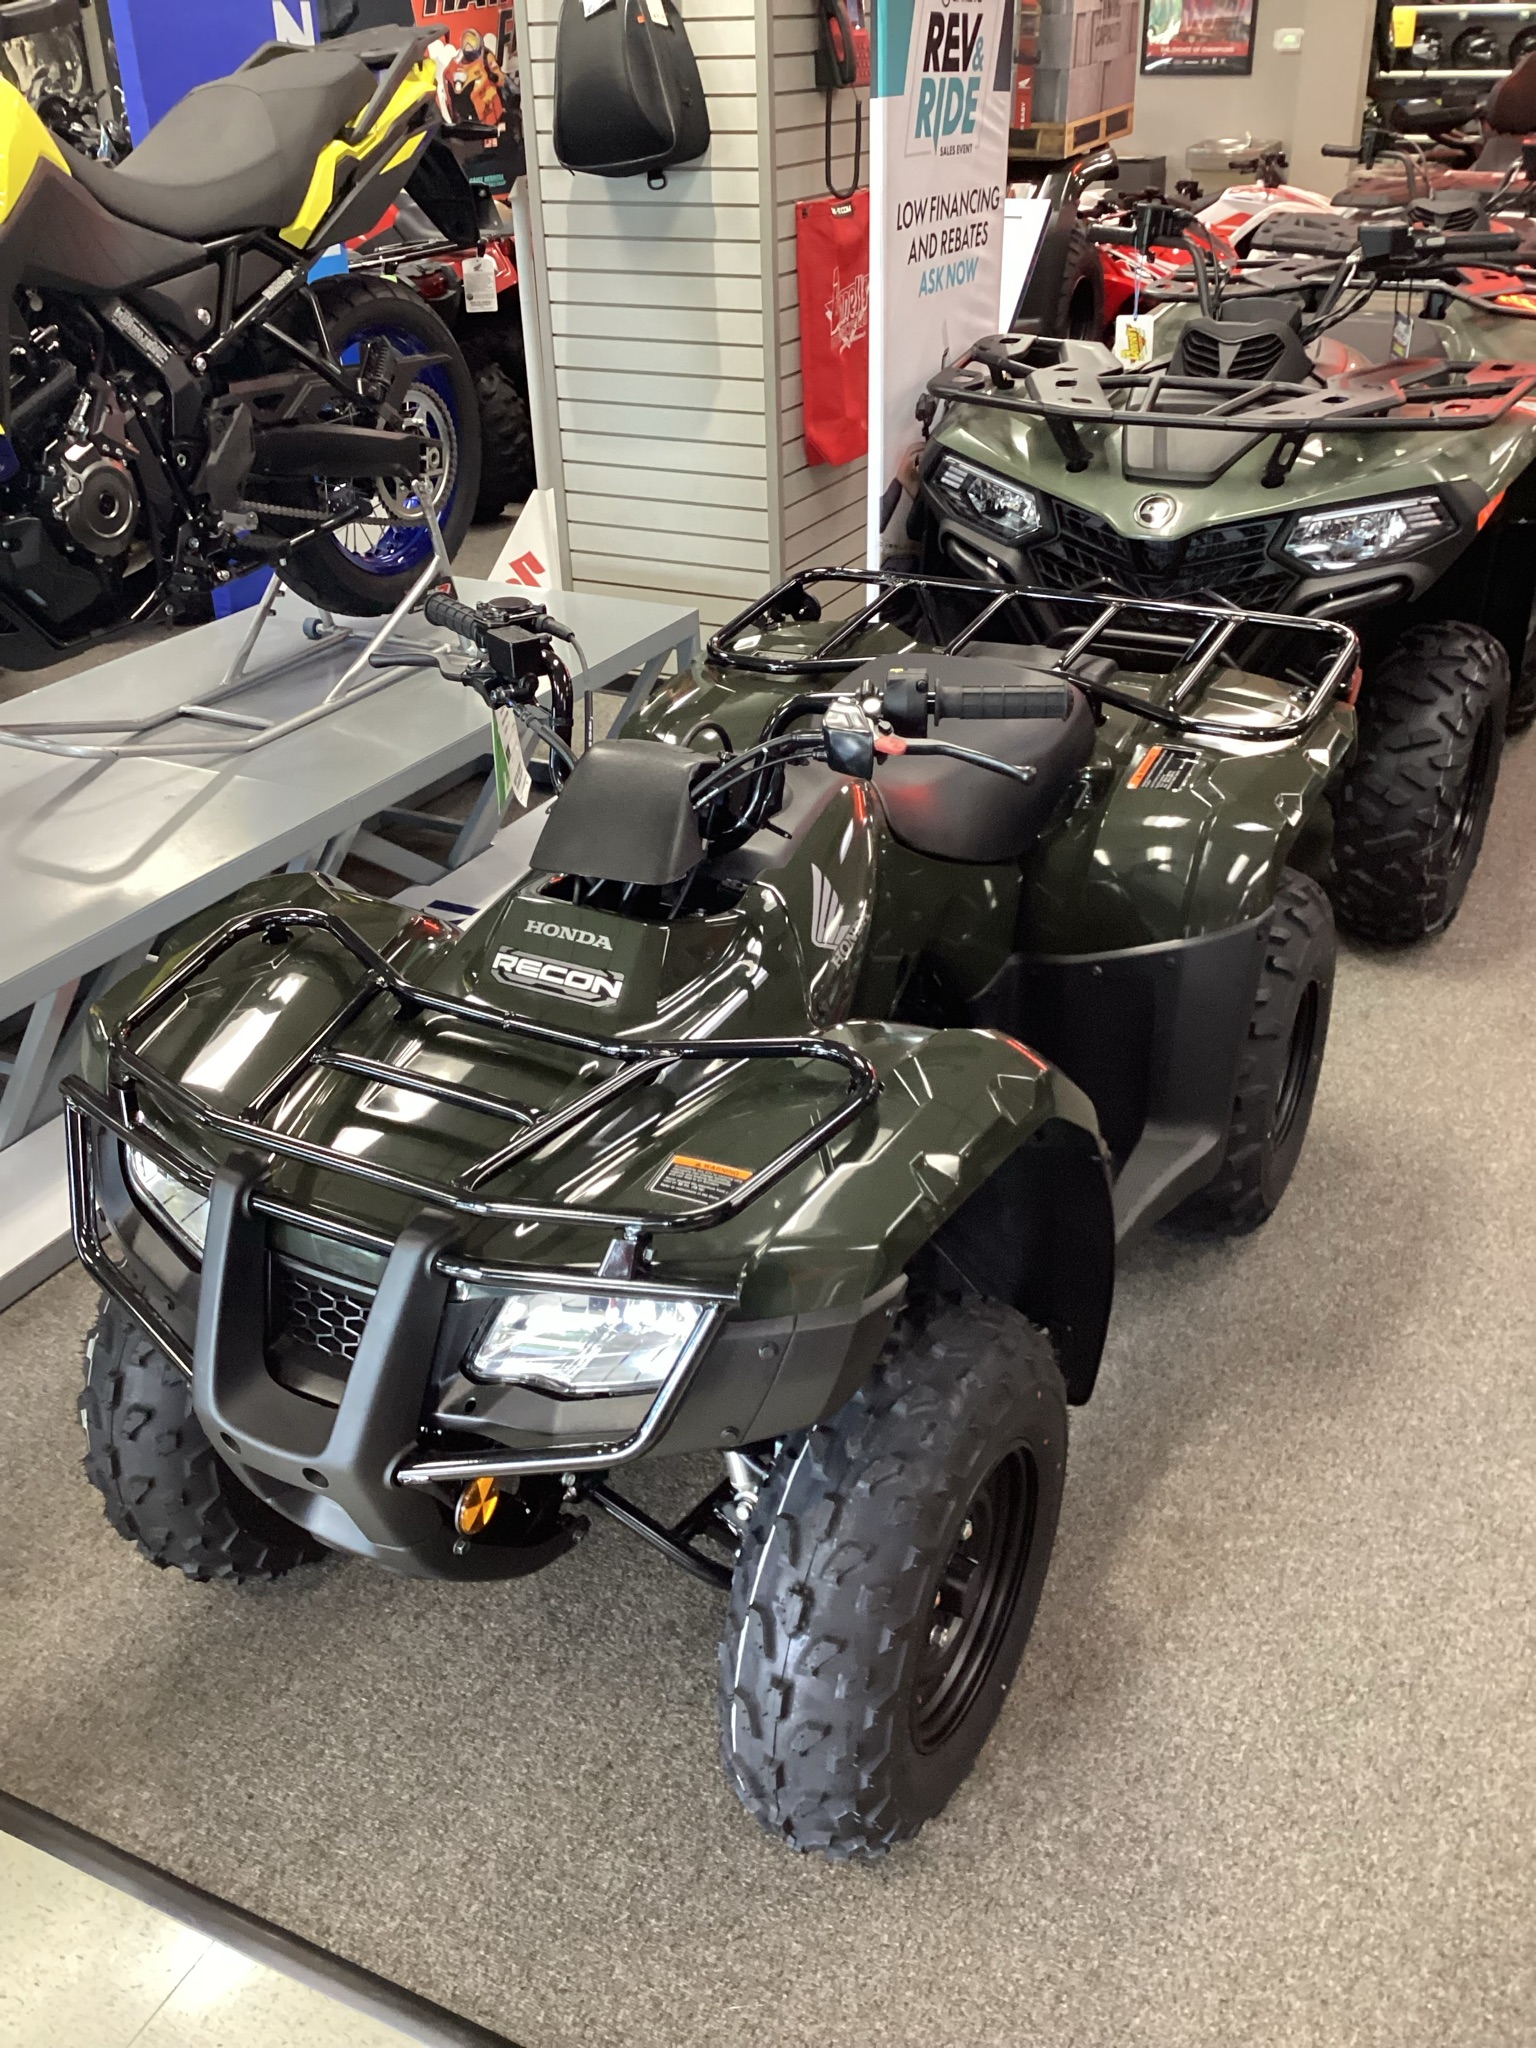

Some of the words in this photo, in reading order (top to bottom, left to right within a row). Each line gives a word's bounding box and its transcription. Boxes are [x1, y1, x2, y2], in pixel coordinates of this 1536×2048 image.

[923, 11, 983, 73] REV
[915, 77, 981, 155] RIDE
[940, 145, 956, 157] SALES
[957, 144, 973, 155] EVENT
[897, 197, 928, 231] LOW
[929, 185, 1000, 223] FINANCING
[907, 233, 938, 266] AND
[940, 221, 989, 257] REBATES
[918, 265, 945, 298] ASK
[946, 256, 979, 290] NOW
[524, 919, 613, 951] HONDA
[491, 952, 623, 999] RECON
